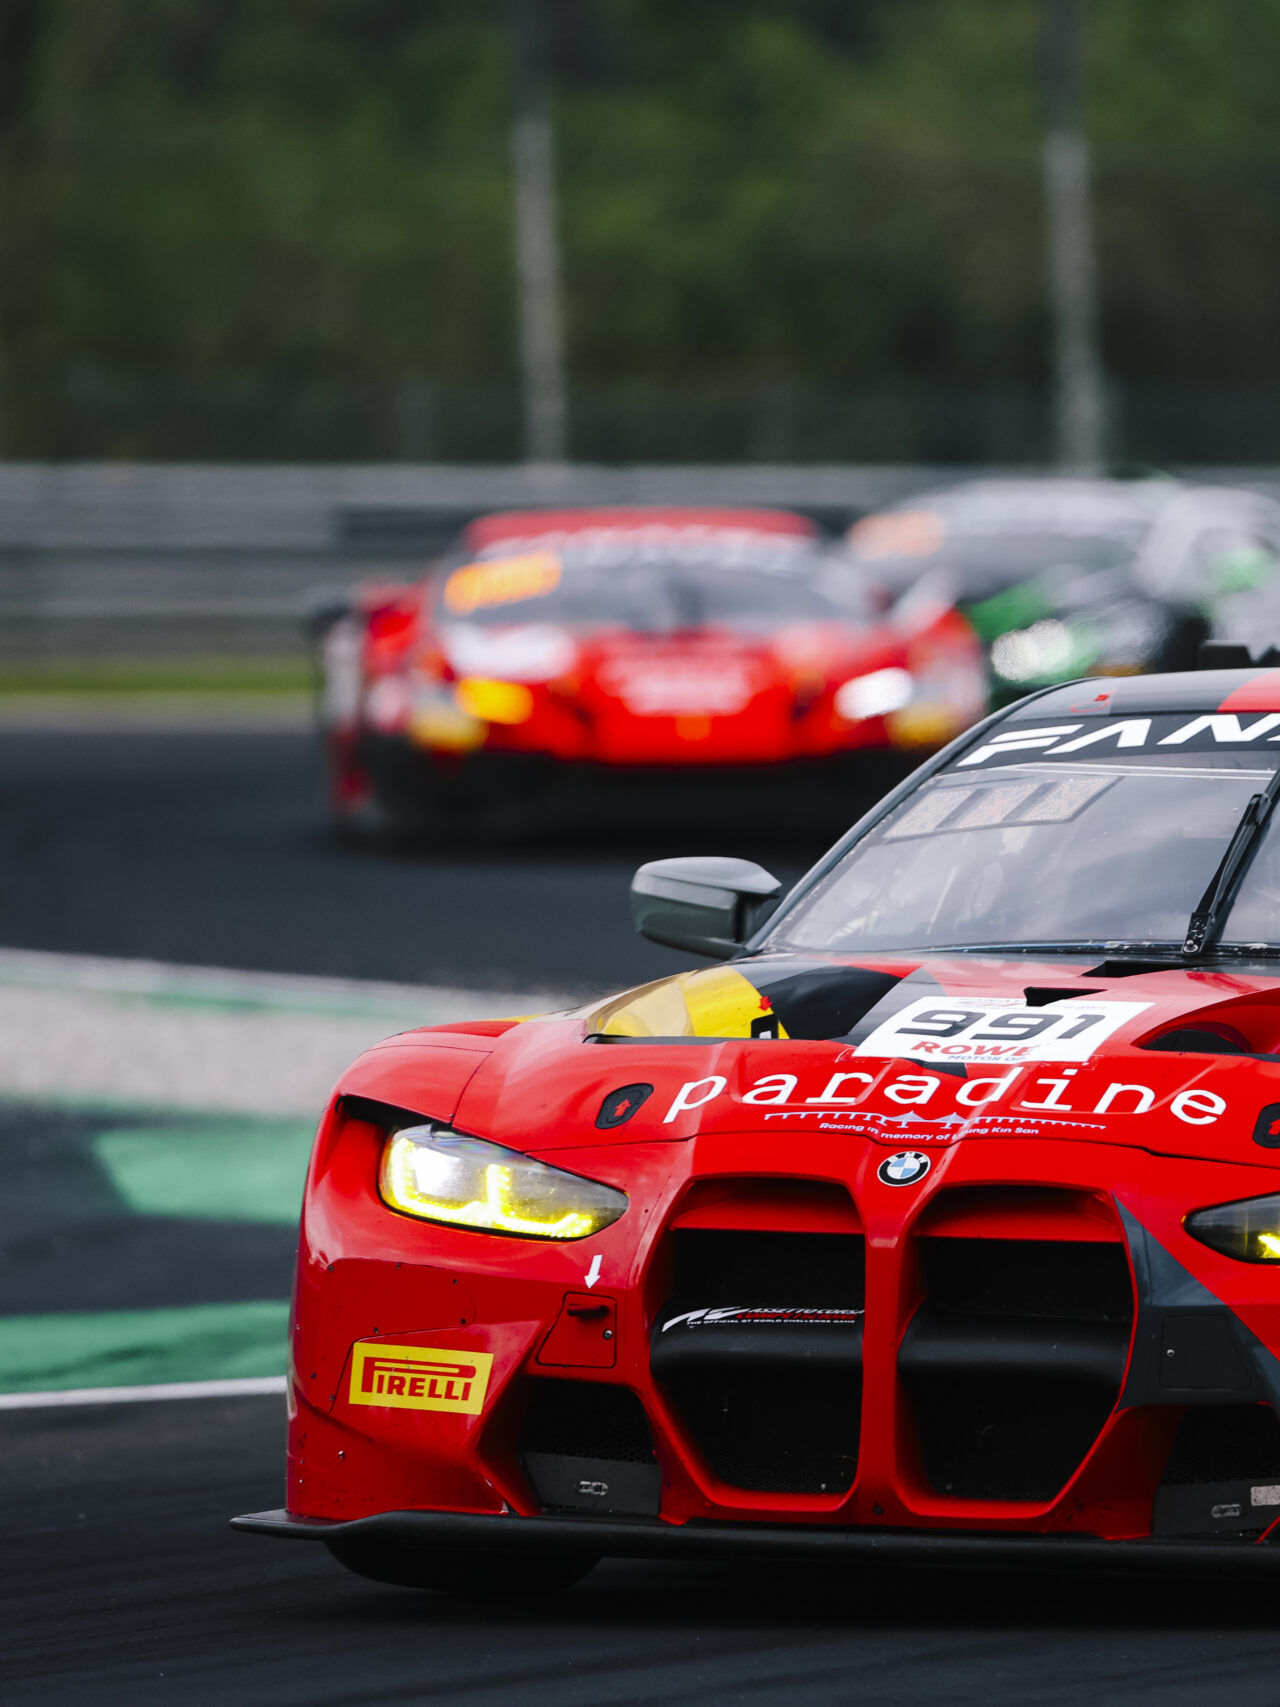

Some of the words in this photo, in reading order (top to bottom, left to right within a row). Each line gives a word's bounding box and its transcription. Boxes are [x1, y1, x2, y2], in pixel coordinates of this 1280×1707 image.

[894, 1009, 1106, 1041] 991
[911, 1041, 1033, 1056] ROWE
[662, 1067, 1228, 1125] paradine
[819, 1122, 865, 1131] Racing
[867, 1126, 879, 1134] in
[881, 1133, 933, 1141] memory
[361, 1356, 477, 1401] PIRELLI
